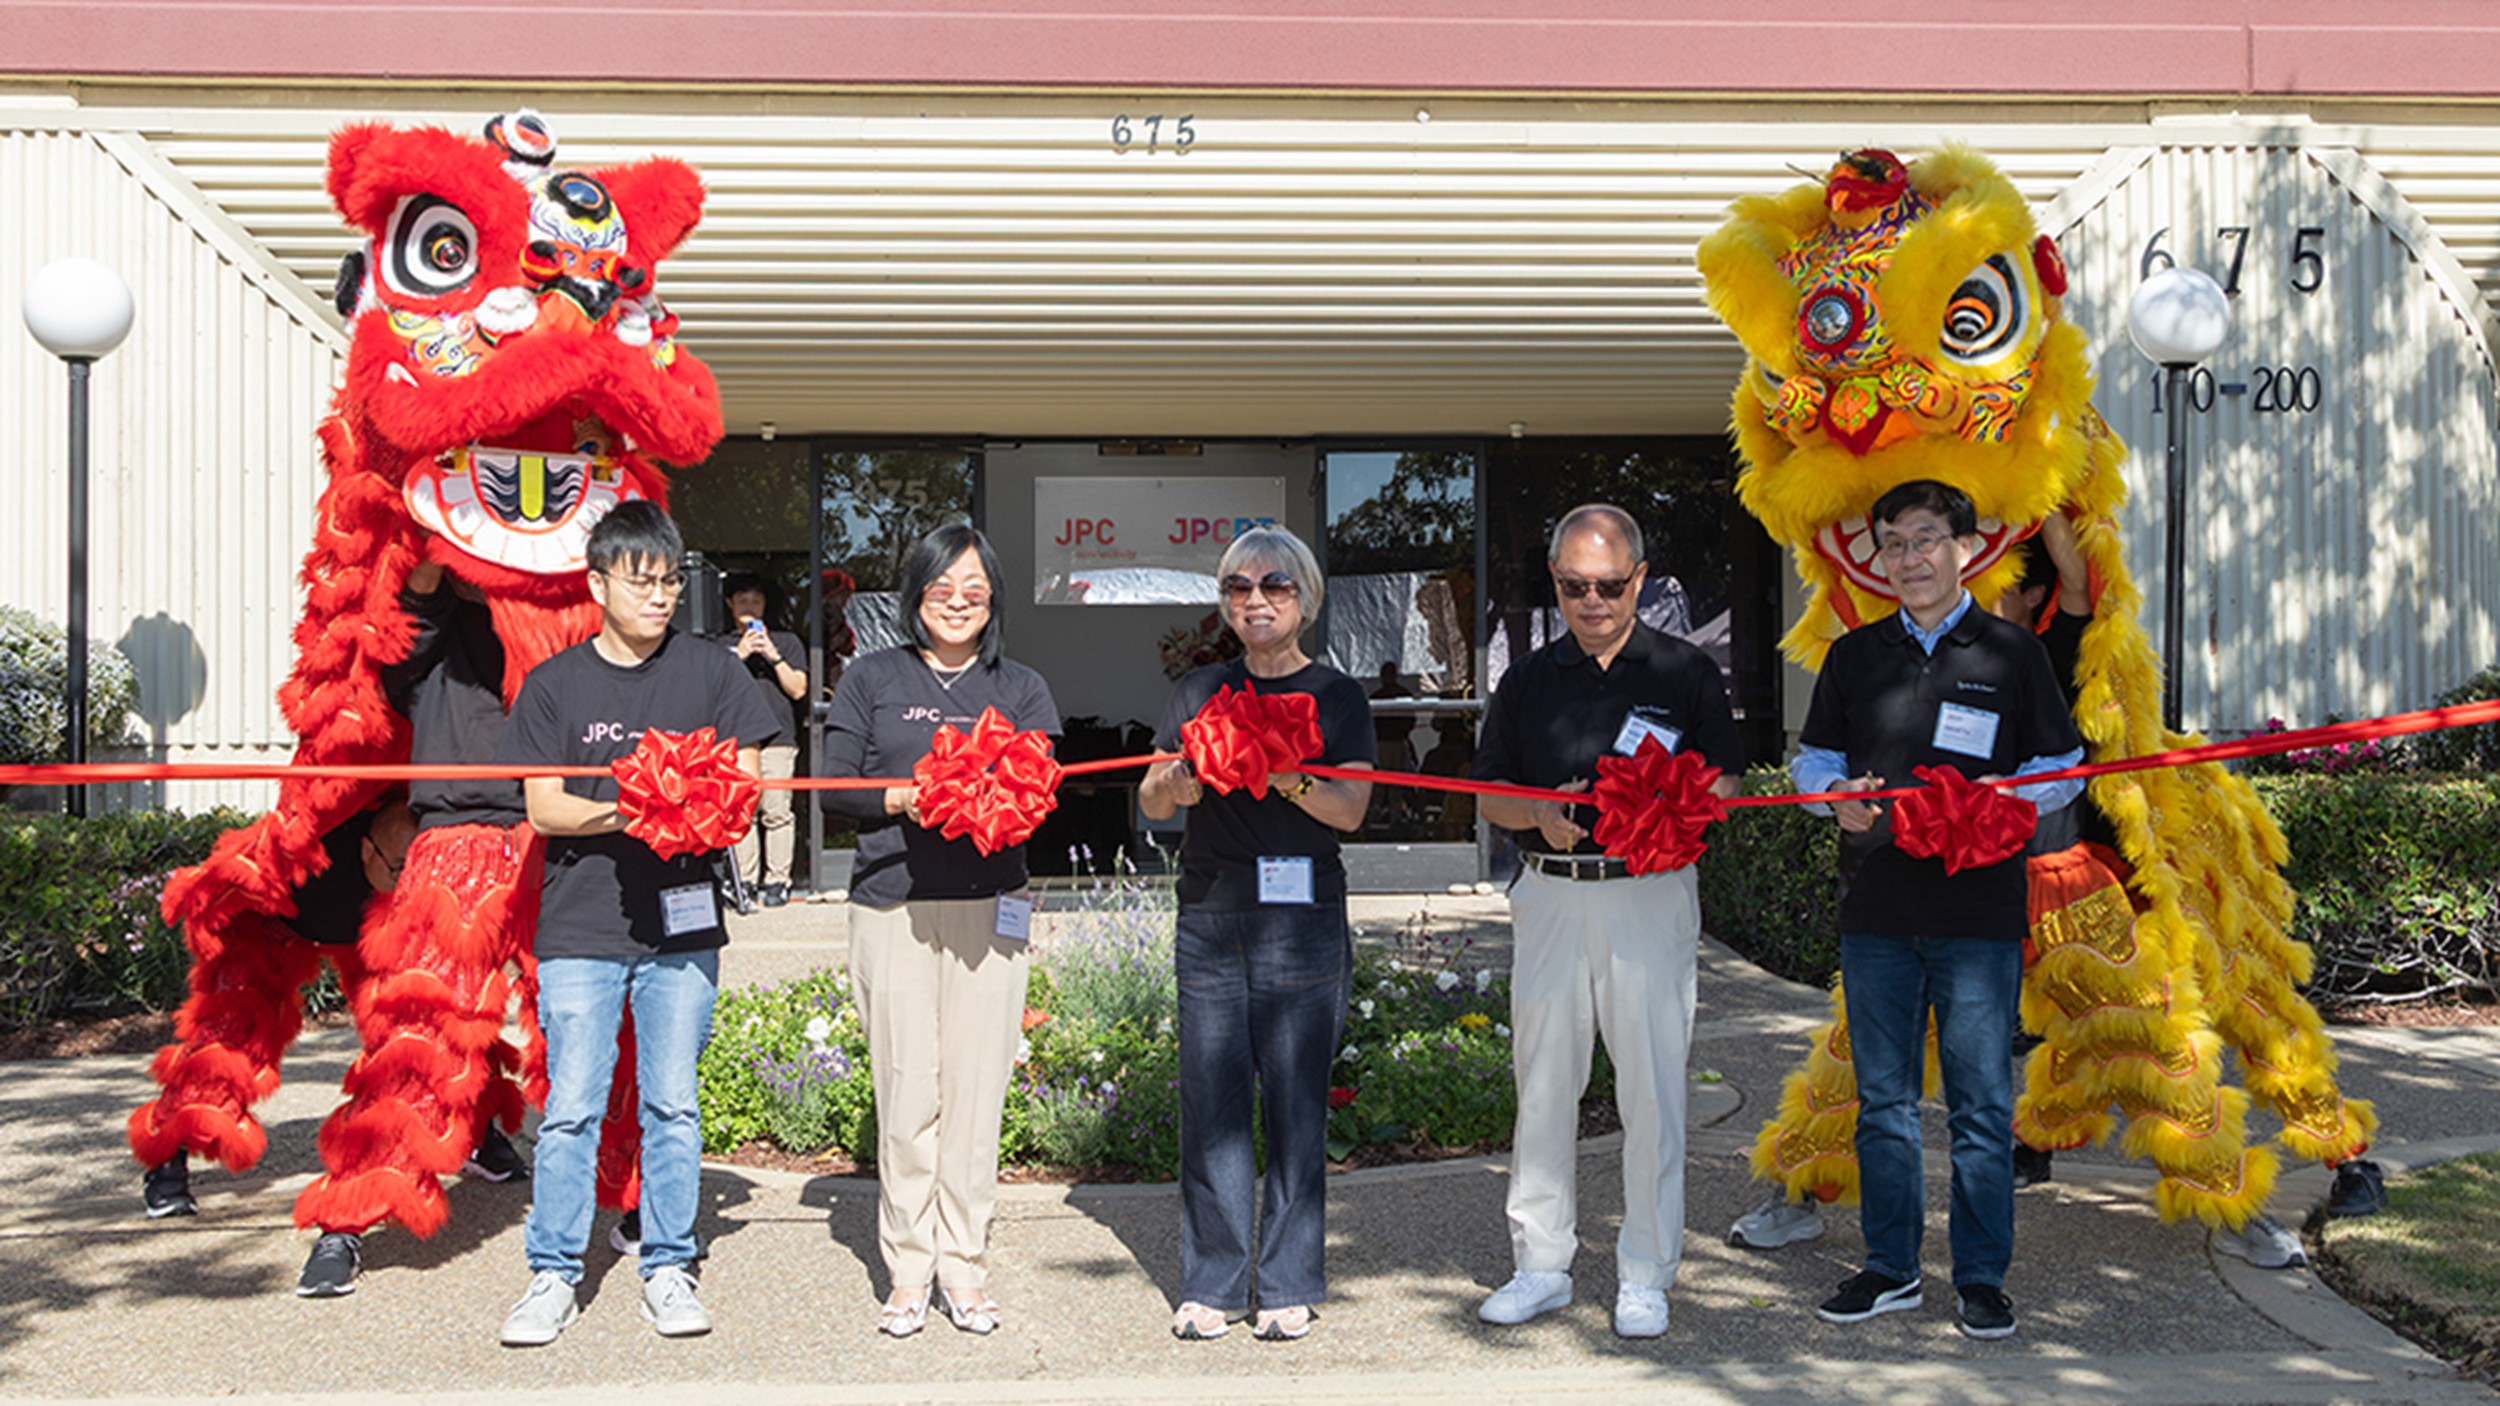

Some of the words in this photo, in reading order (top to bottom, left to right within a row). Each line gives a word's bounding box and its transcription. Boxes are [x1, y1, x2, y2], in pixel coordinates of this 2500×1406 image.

[1111, 113, 1195, 146] 675
[2151, 366, 2322, 413] 10-200
[1055, 518, 1116, 545] JPC
[901, 707, 941, 723] JPC
[581, 722, 625, 744] JPC
